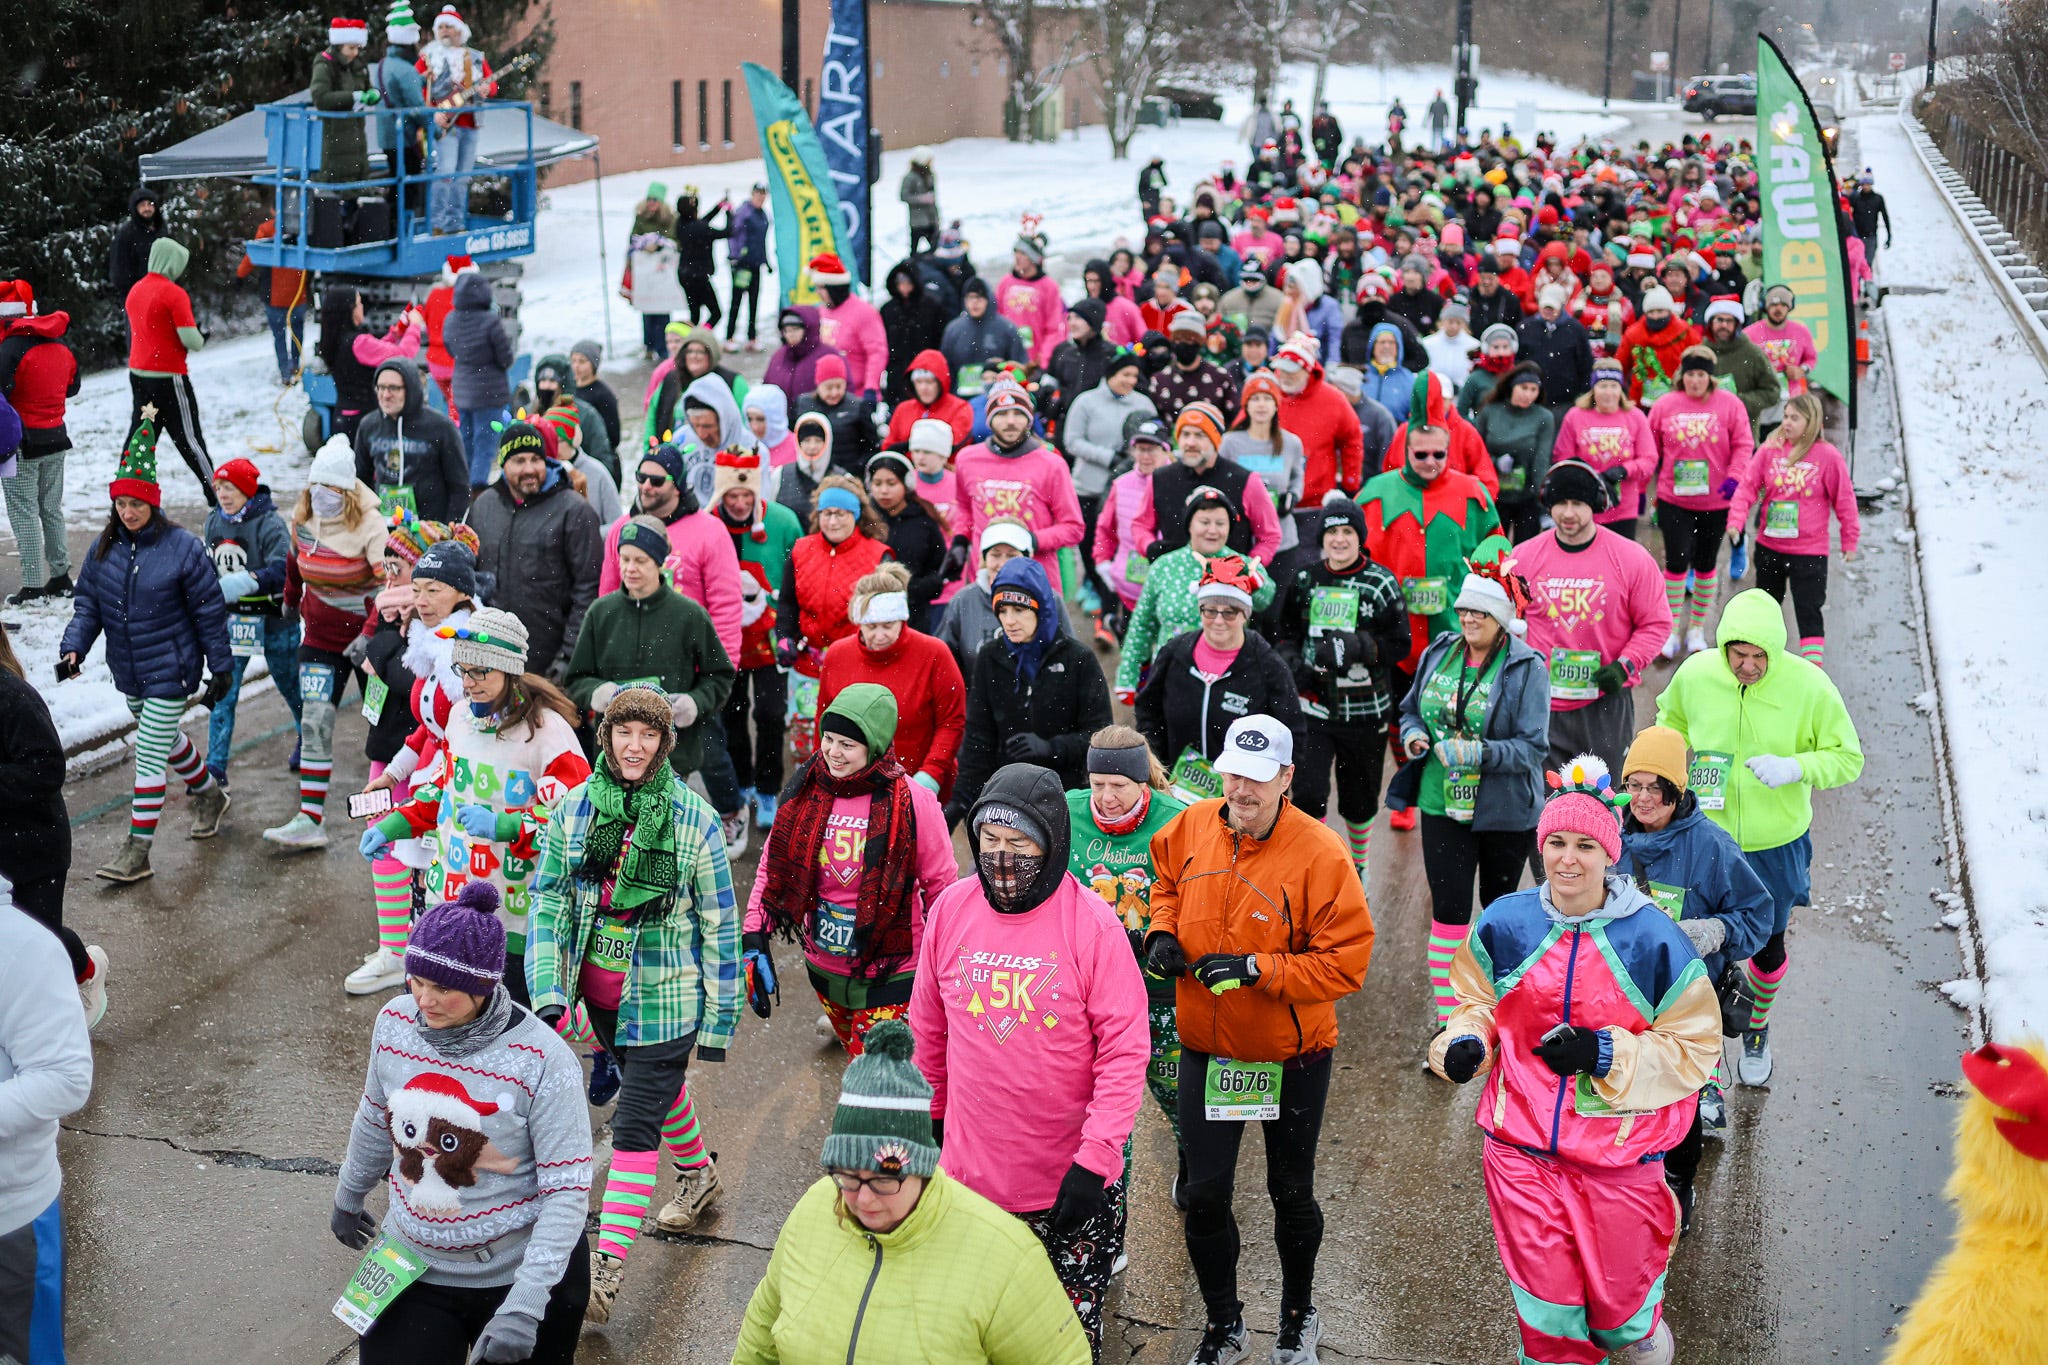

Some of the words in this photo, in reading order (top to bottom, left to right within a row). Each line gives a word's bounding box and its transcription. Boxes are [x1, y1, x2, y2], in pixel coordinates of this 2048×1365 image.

[995, 489, 1021, 511] 5K
[1561, 588, 1592, 613] 5K
[1319, 602, 1350, 618] 7007
[232, 624, 256, 640] 1874
[301, 676, 326, 692] 1937
[1238, 734, 1265, 748] 26.2
[456, 767, 463, 782] 2
[478, 774, 488, 789] 3
[1183, 765, 1216, 793] 6805
[1691, 768, 1720, 786] 6838
[511, 780, 525, 795] 4
[539, 783, 556, 801] 17
[449, 844, 462, 862] 10
[824, 828, 835, 840] LF
[833, 830, 867, 862] 5K
[1086, 838, 1148, 865] Christmas
[474, 853, 486, 870] 11
[506, 856, 524, 872] 12
[427, 870, 438, 890] 13
[507, 891, 526, 908] 16
[819, 918, 854, 946] 2217
[595, 933, 632, 960] 6783
[970, 951, 1042, 971] SELFLESS
[972, 967, 990, 983] ELF
[989, 970, 1037, 1012] 5K
[1219, 1068, 1269, 1093] 6676
[1227, 1109, 1259, 1117] SUBWAY
[383, 1247, 417, 1272] SUBWAY
[354, 1258, 397, 1298] 6696
